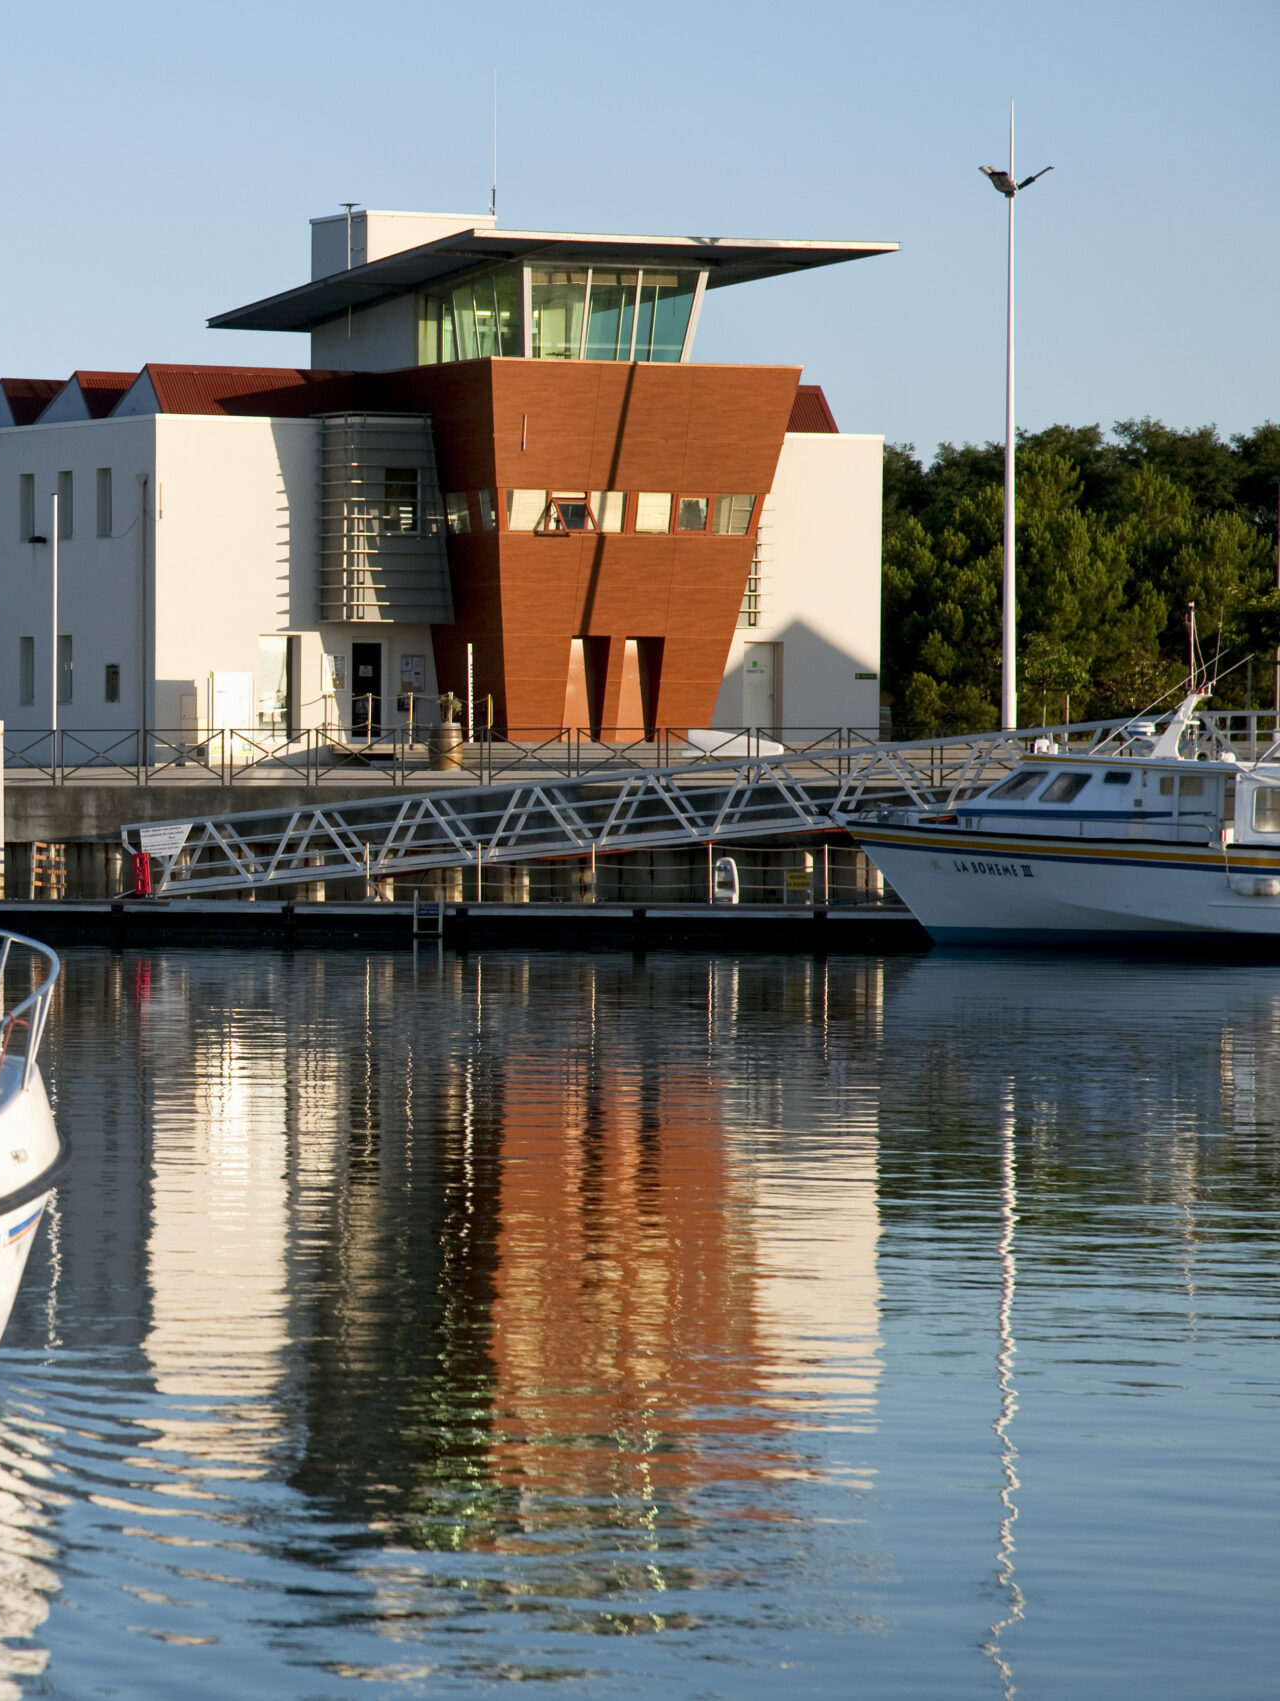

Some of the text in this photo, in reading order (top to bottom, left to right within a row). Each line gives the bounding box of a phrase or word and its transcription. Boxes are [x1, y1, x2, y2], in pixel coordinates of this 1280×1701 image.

[953, 860, 1035, 877] LA BOHEME III
